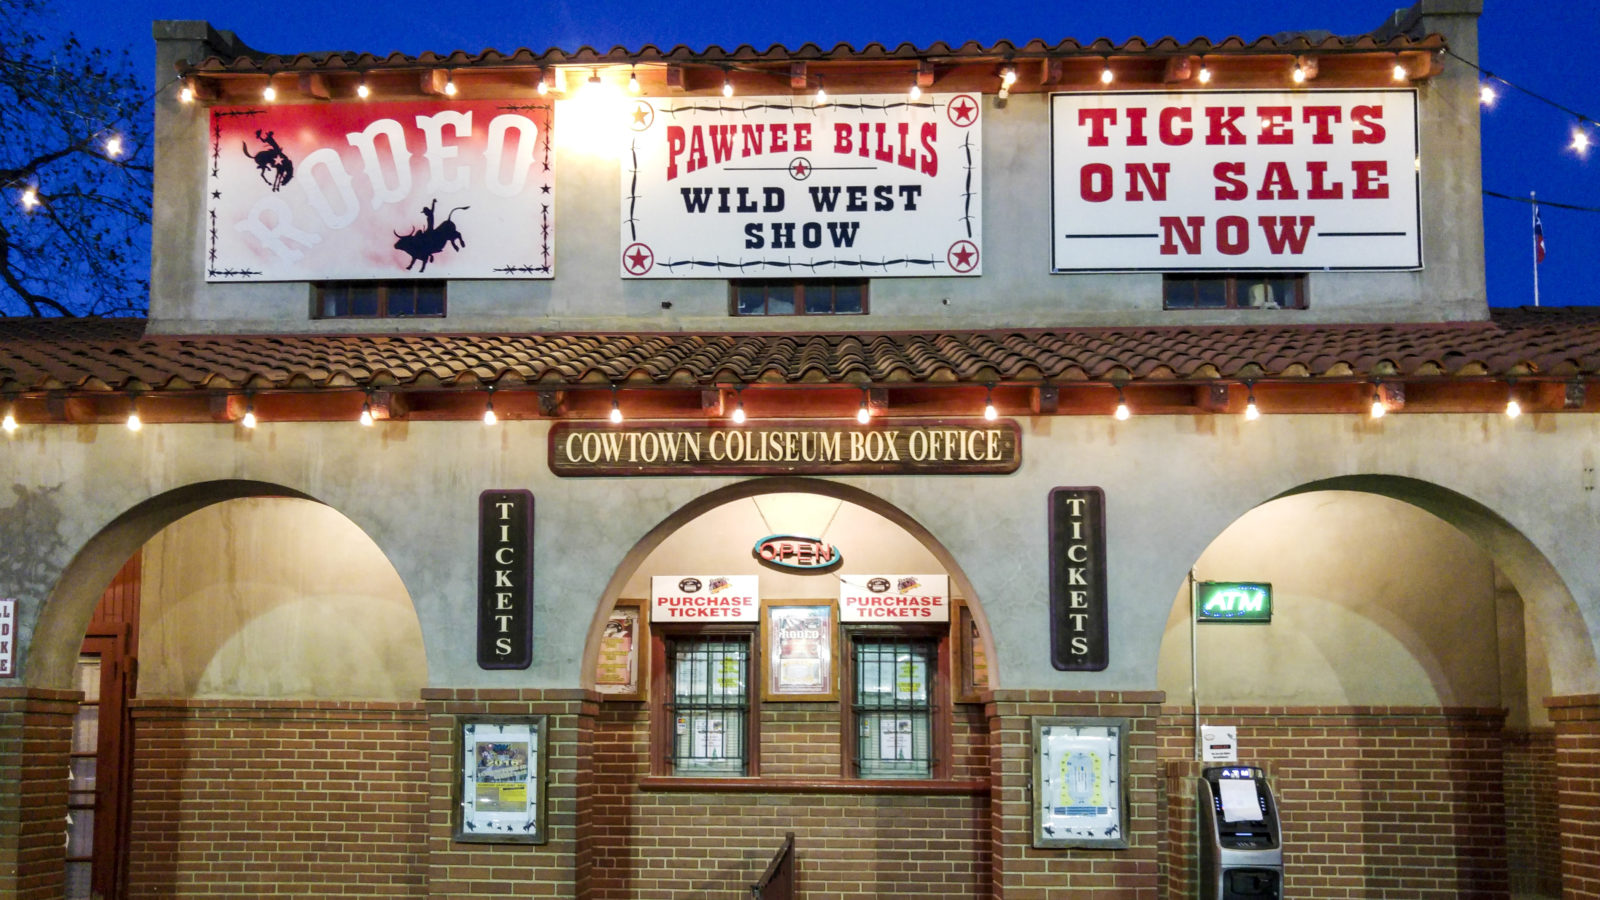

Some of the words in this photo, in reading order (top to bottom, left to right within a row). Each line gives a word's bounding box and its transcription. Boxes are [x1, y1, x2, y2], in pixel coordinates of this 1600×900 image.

[1078, 105, 1387, 146] TICKETS
[667, 123, 812, 181] PAWNEE
[834, 121, 938, 178] BILLS
[234, 110, 539, 264] RODEO
[1080, 162, 1171, 203] ON
[1213, 160, 1390, 201] SALE
[680, 187, 785, 213] WILD
[809, 184, 922, 212] WEST
[744, 222, 860, 249] SHOW
[1159, 215, 1316, 256] NOW
[566, 432, 701, 463] COWTOWN
[709, 430, 842, 462] COLISEUM
[849, 430, 900, 462] BOX
[908, 429, 1002, 462] OFFICE
[760, 542, 831, 561] OPEN
[495, 502, 514, 655] TICKETS
[1066, 498, 1088, 655] TICKETS
[657, 596, 753, 607] PURCHASE
[668, 607, 742, 617] TICKETS
[846, 596, 943, 606] PURCHASE
[857, 607, 932, 617] TICKETS
[1205, 591, 1264, 612] ATM
